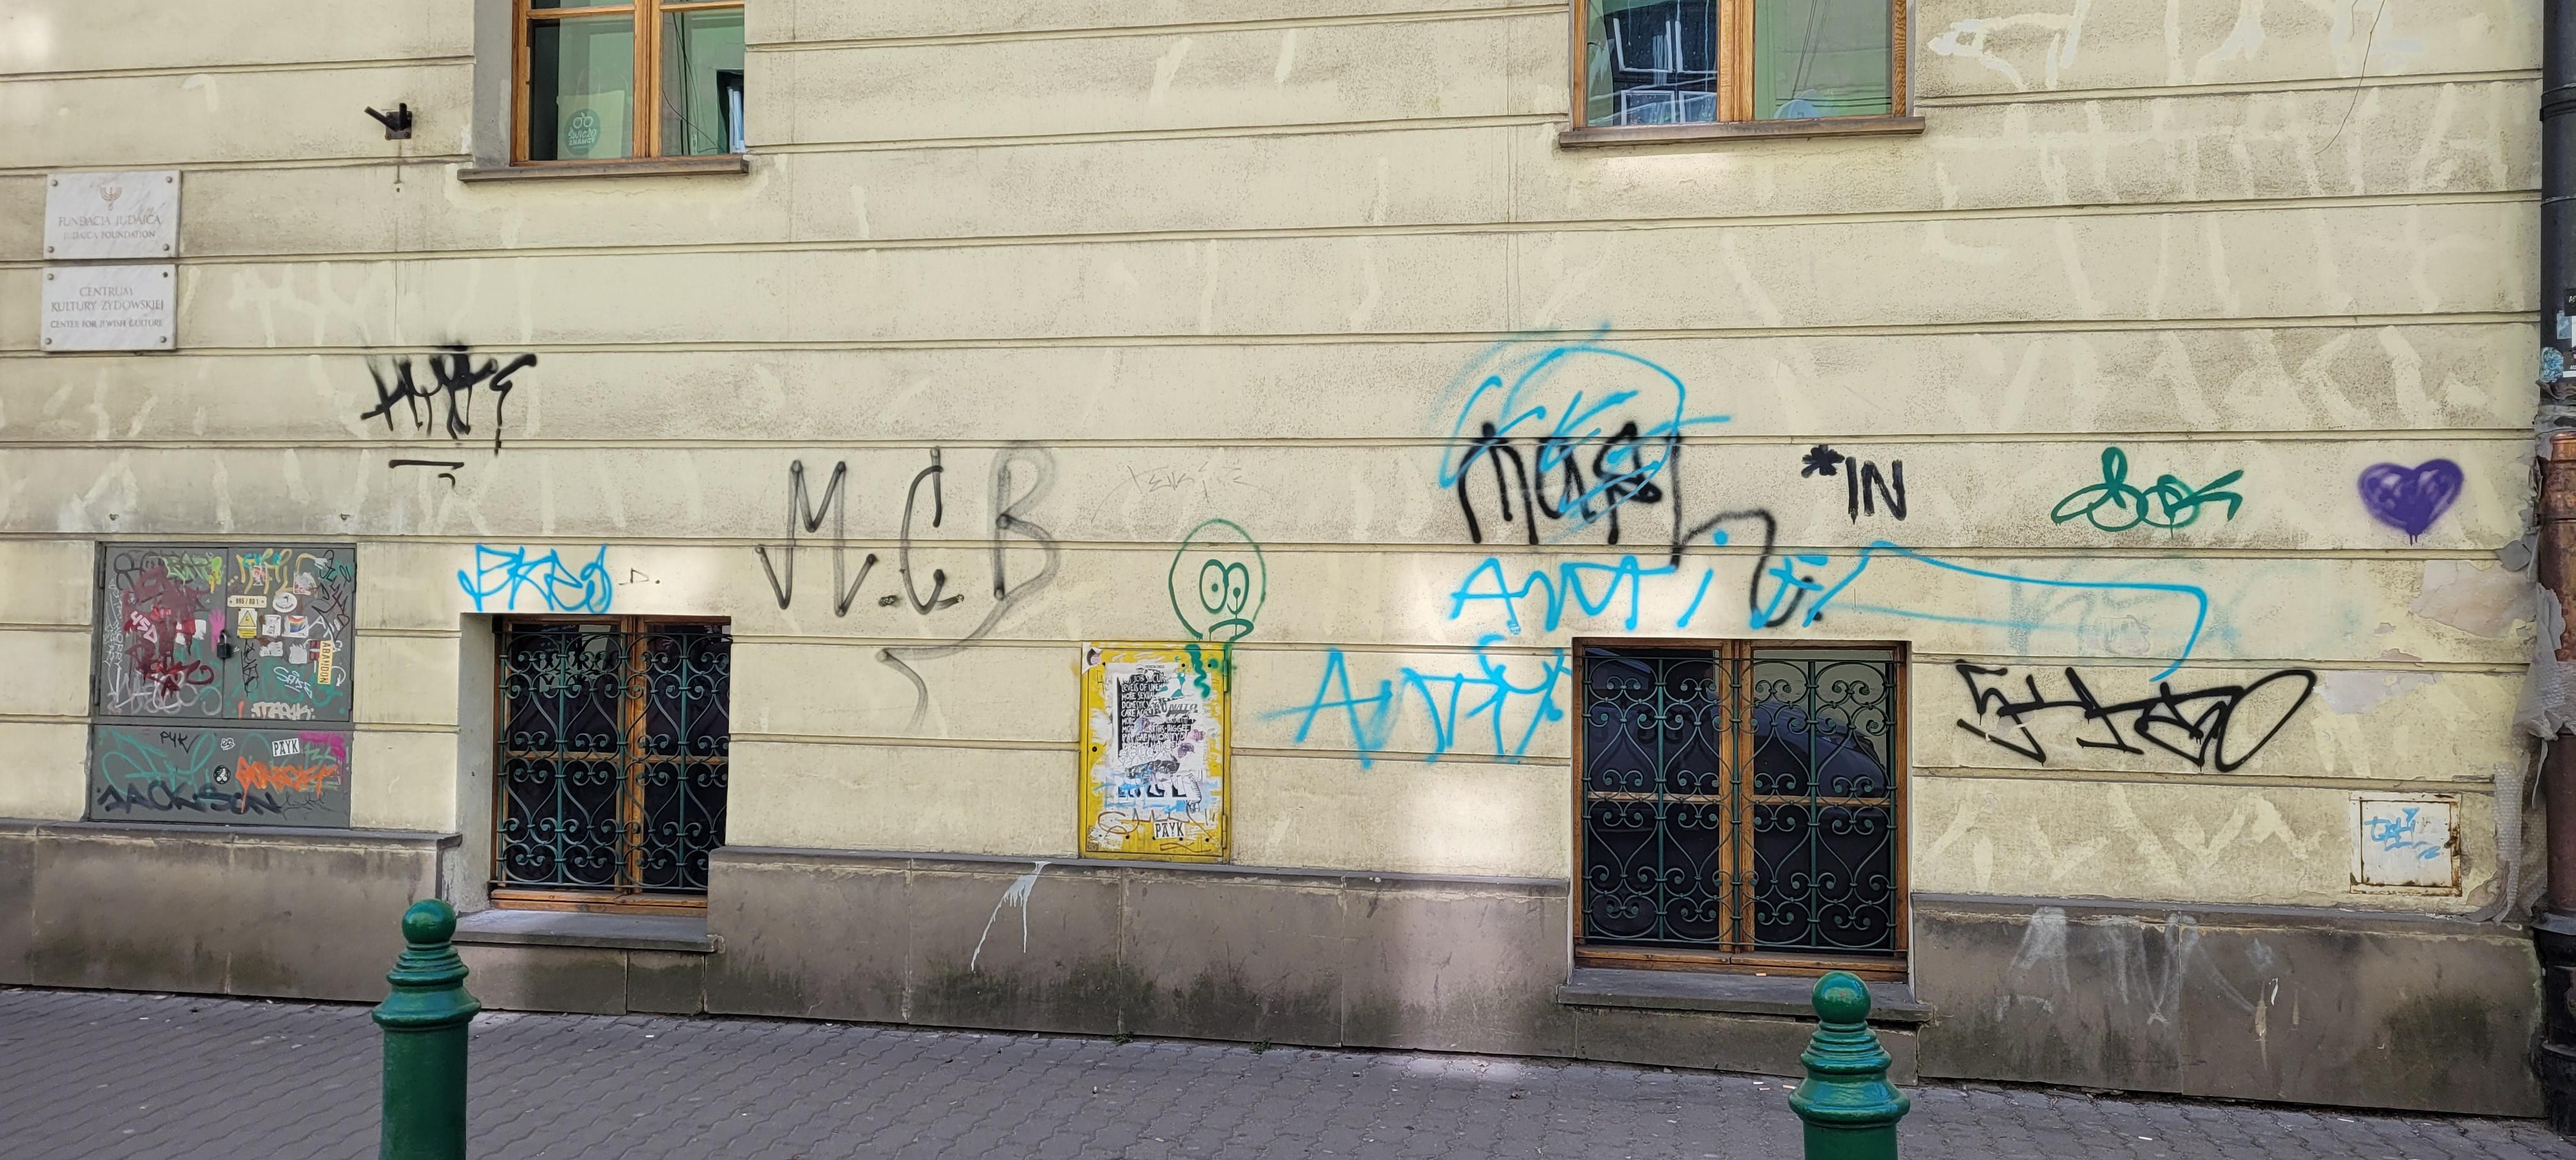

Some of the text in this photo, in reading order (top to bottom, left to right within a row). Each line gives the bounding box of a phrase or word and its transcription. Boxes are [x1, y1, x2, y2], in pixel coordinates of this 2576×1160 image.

[116, 214, 161, 225] JUDAICA
[102, 230, 155, 239] FOUNDATION
[80, 287, 133, 296] CENTRUM
[51, 301, 96, 312] KULTURY
[317, 641, 333, 685] ABANDON
[1134, 675, 1145, 683] JOB
[1122, 692, 1136, 701] MORE
[274, 740, 298, 755] PAYK
[1155, 822, 1184, 837] PAYK
